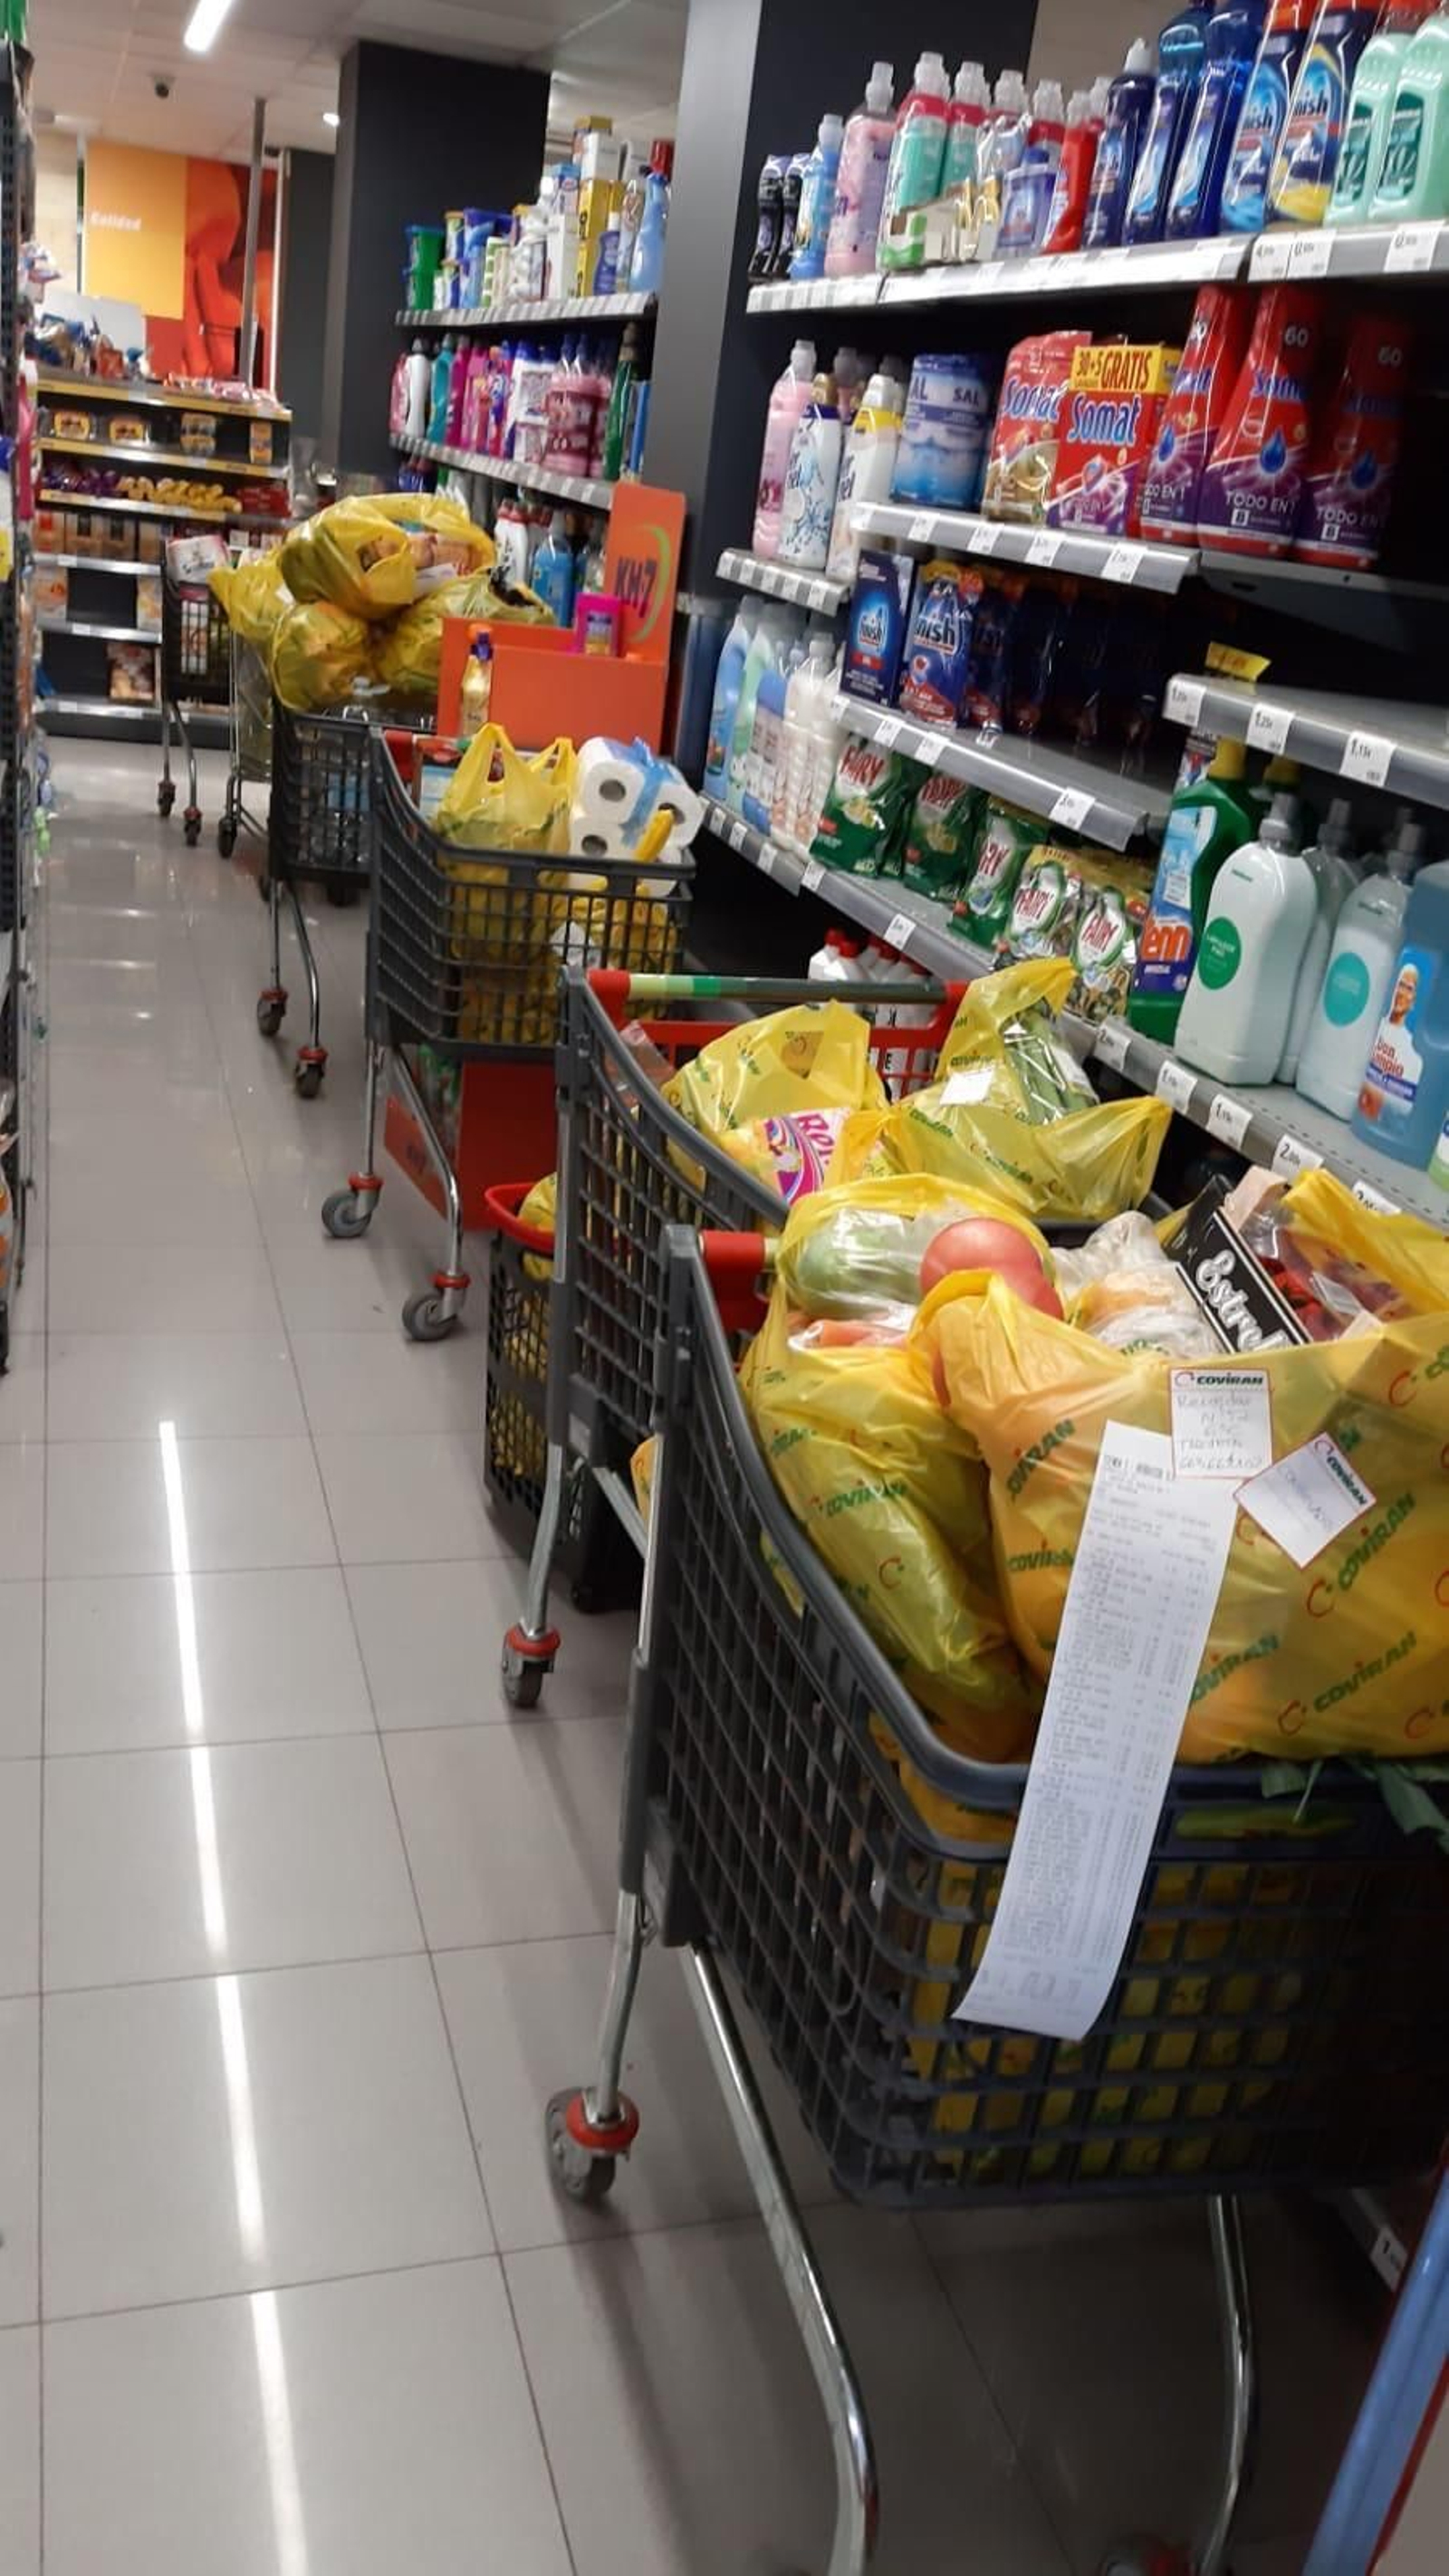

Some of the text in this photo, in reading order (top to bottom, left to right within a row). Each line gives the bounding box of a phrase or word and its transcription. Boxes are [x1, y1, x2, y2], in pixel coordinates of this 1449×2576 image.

[1284, 324, 1309, 348] 60
[1377, 345, 1403, 366] 60
[1100, 349, 1153, 390] GRATIS
[952, 386, 979, 407] SAL
[1067, 393, 1142, 447] Somat
[1224, 490, 1266, 511] TODO
[1270, 499, 1289, 514] EN
[1316, 506, 1357, 525] TODO
[615, 555, 657, 619] KH7
[914, 612, 956, 645] nish
